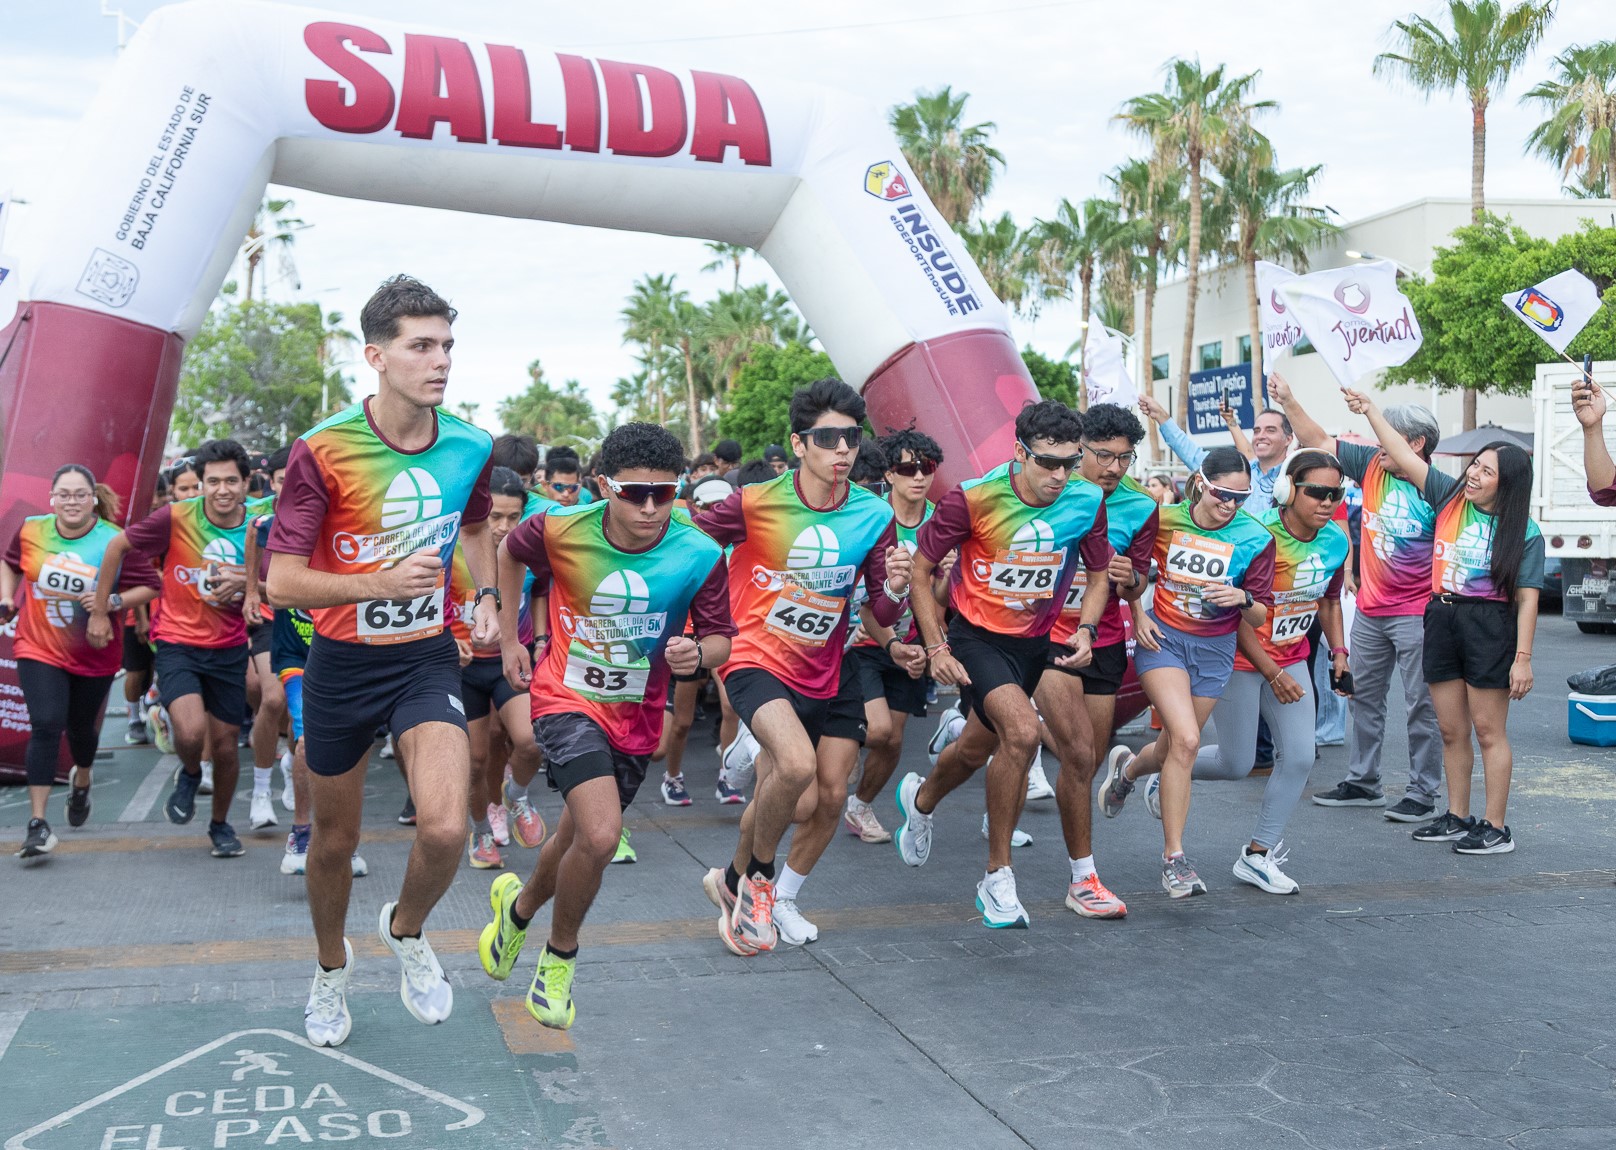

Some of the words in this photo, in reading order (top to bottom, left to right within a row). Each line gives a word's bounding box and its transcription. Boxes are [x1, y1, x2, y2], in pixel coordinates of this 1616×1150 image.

[303, 21, 772, 167] SALIDA
[116, 178, 152, 241] GOBIERNO
[146, 154, 165, 177] DEL
[157, 104, 186, 152] ESTADO
[180, 84, 195, 103] DE
[131, 212, 158, 250] BAJA
[151, 125, 198, 209] CALIFORNIA
[190, 93, 212, 124] SUR
[897, 204, 980, 316] INSUDE
[1188, 375, 1217, 397] Terminal
[1196, 413, 1205, 430] La
[1205, 413, 1219, 429] Paz
[374, 530, 410, 547] CARRERA
[412, 527, 425, 537] DEL
[441, 520, 455, 539] 5K
[385, 534, 437, 556] ESTUDIANTE
[1169, 550, 1224, 578] 480
[47, 571, 85, 594] 619
[836, 571, 848, 583] 5K
[995, 568, 1053, 588] 478
[365, 596, 438, 629] 634
[584, 619, 616, 629] CARRERA
[619, 617, 630, 627] DEL
[632, 615, 643, 626] DÍA
[774, 606, 835, 636] 465
[596, 626, 643, 640] ESTUDIANTE
[648, 618, 660, 632] 5K
[1275, 614, 1312, 637] 470
[584, 666, 629, 691] 83
[164, 1082, 347, 1117] CEDA
[102, 1123, 186, 1150] EL
[214, 1108, 412, 1148] PASO
